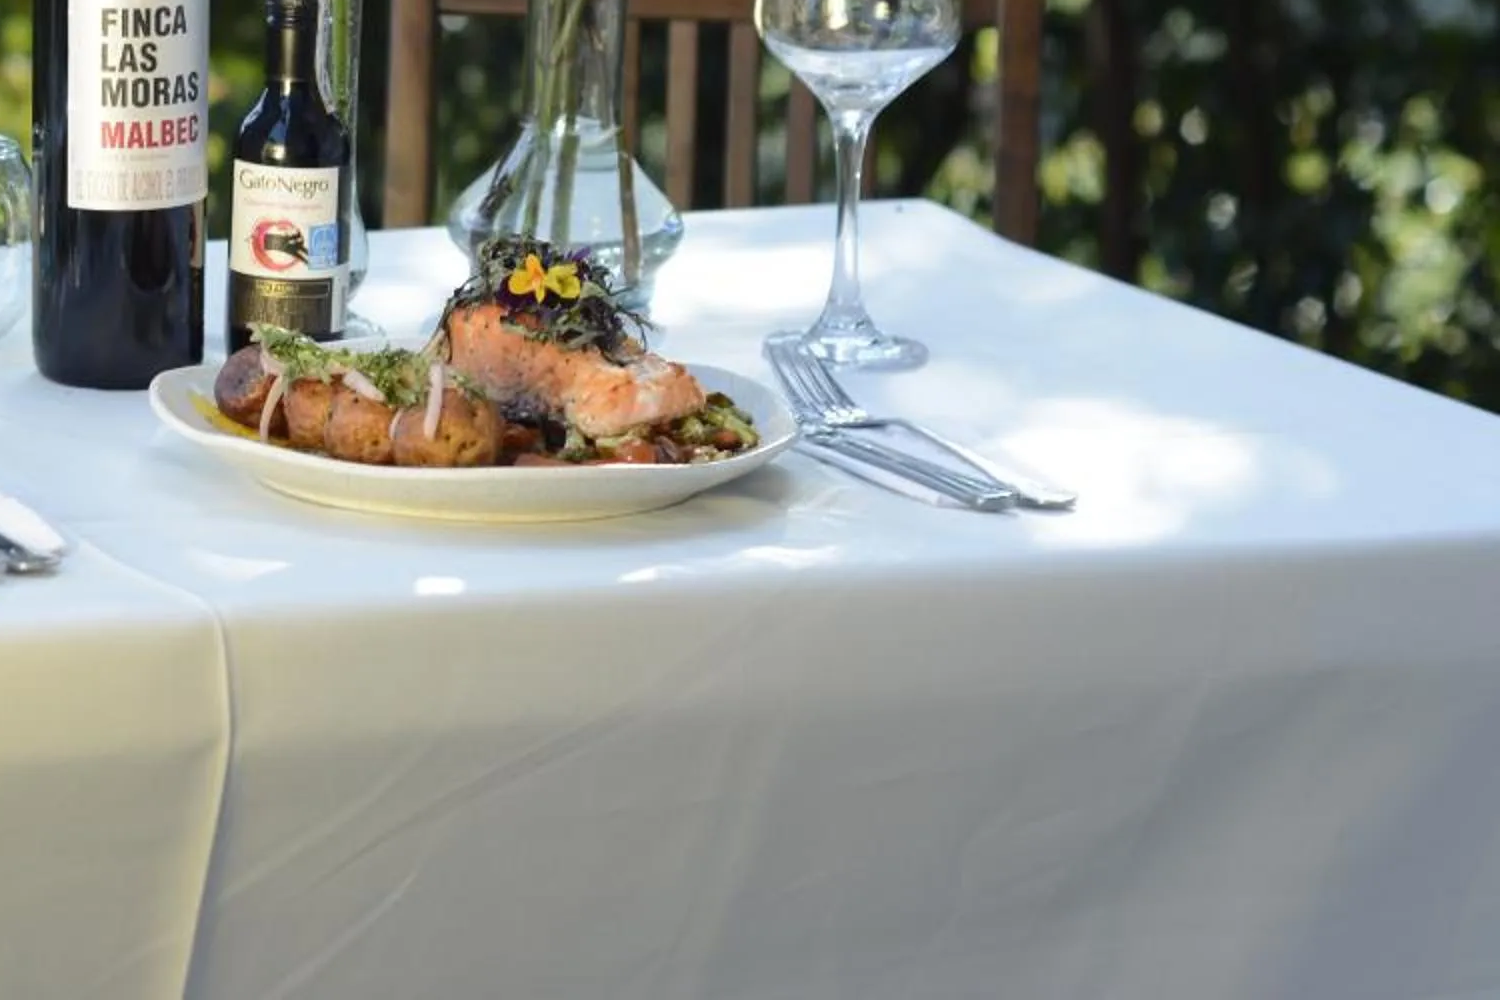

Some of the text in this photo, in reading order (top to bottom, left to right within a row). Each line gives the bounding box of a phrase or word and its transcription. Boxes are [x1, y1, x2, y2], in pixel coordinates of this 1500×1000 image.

[101, 5, 188, 39] FINCA
[101, 42, 158, 74] LAS
[101, 71, 199, 108] MORAS
[101, 115, 199, 149] MALBEC
